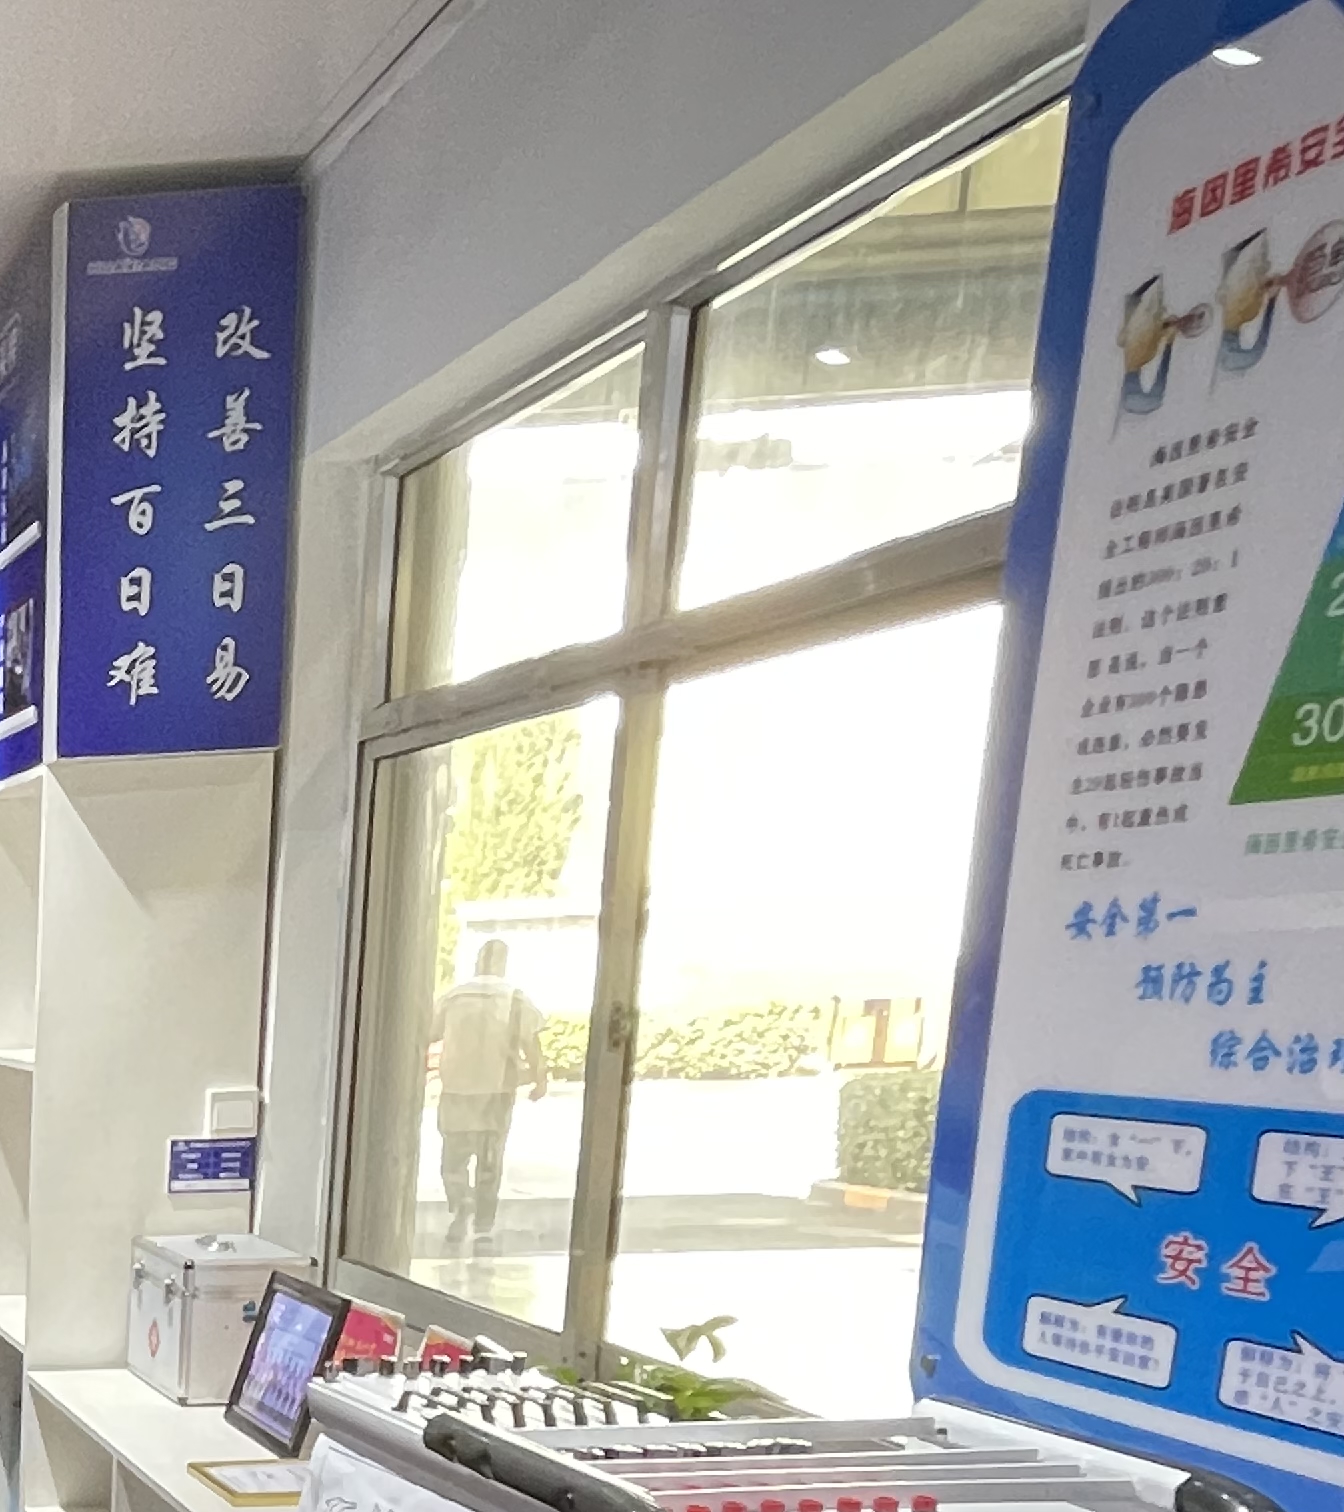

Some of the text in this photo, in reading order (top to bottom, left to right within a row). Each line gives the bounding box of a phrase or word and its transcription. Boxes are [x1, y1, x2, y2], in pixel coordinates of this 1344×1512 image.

[107, 306, 167, 705] 坚持百日难
[205, 305, 271, 702] 改善三日易
[1064, 891, 1198, 941] 安全第一
[1134, 959, 1268, 1007] 预防为主
[1157, 1232, 1276, 1300] 安全
